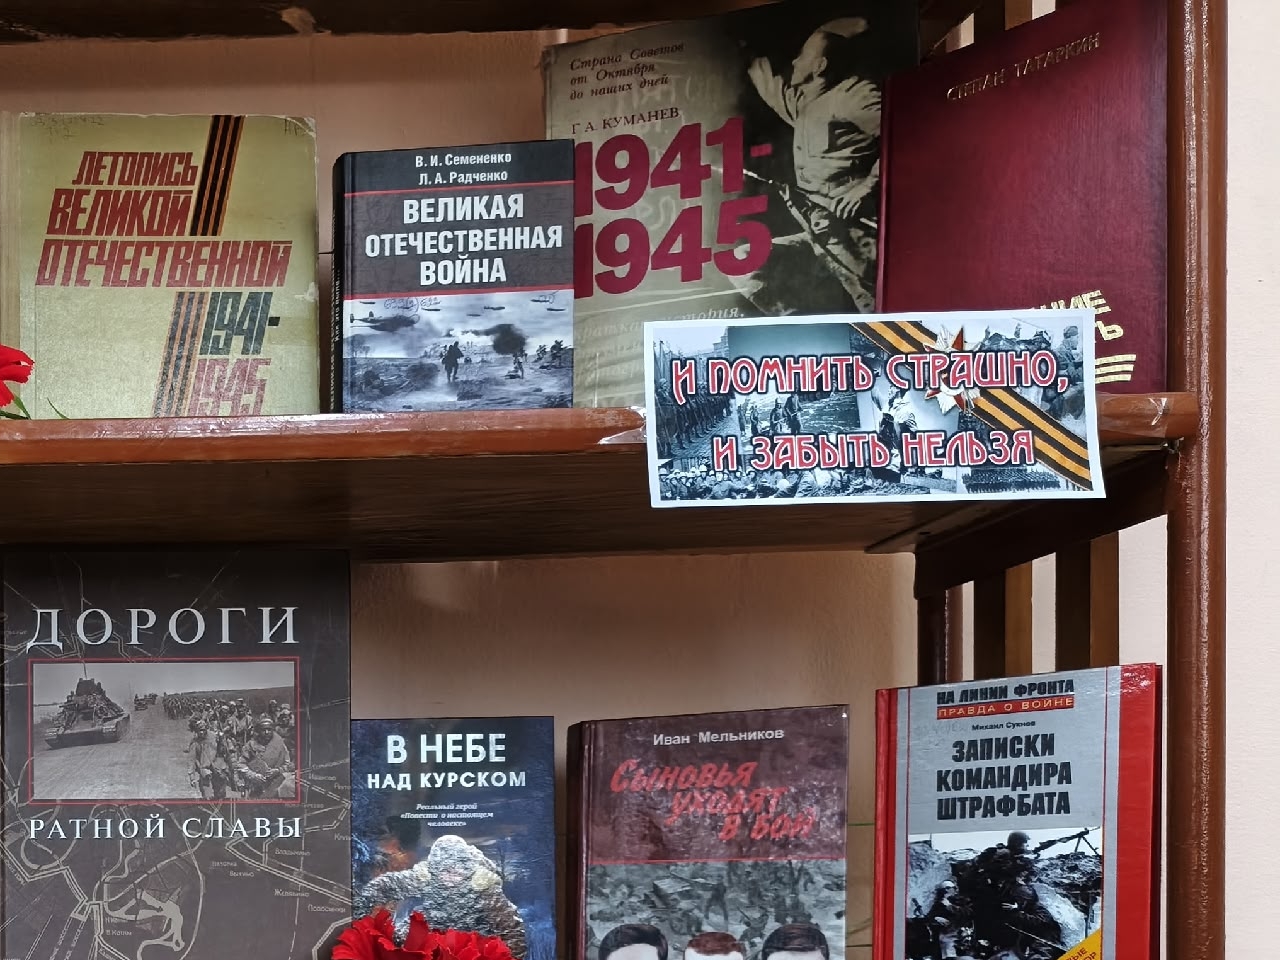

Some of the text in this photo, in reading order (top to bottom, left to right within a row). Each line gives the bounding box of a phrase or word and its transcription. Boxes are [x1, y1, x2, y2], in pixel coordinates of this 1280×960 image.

[570, 55, 622, 71] Страна
[601, 73, 669, 97] наших дней
[603, 107, 679, 129] КУМАНЕВ
[75, 151, 199, 186] ЛЕТОПИСЬ
[445, 151, 512, 167] Семененко
[450, 168, 508, 185] Радченко
[47, 187, 196, 237] ВЕЛИКОЙ
[403, 193, 524, 226] ВЕЛИКАЯ
[365, 225, 563, 259] ОТЕЧЕСТВЕННАЯ
[574, 194, 773, 299] 1945
[35, 238, 293, 289] ОТЕЧЕСТВЕННОЙ
[420, 254, 507, 287] ВОЙНА
[709, 351, 1069, 394] ПОМНИТЬ СТРАШНО,
[750, 431, 1036, 470] ЗАБЫТЬ НЕЛЬЗЯ
[26, 606, 300, 653] ДОРОГИ
[937, 679, 1075, 705] НА ЛИНИИ ФРОНТА
[938, 696, 1075, 718] ПРАВДА ВОЙНЕ
[653, 729, 785, 746] Иван Мельников
[971, 722, 1004, 731] Михаил
[420, 733, 507, 763] НЕБЕ
[952, 732, 1055, 763] ЗАПИСКИ
[367, 771, 527, 791] НАД КУРСКОМ
[936, 761, 1072, 792] КОМАНДИРА
[937, 791, 1071, 821] ШТРАФБАТА
[28, 813, 303, 840] РАТНОЙ СЛАВЫ
